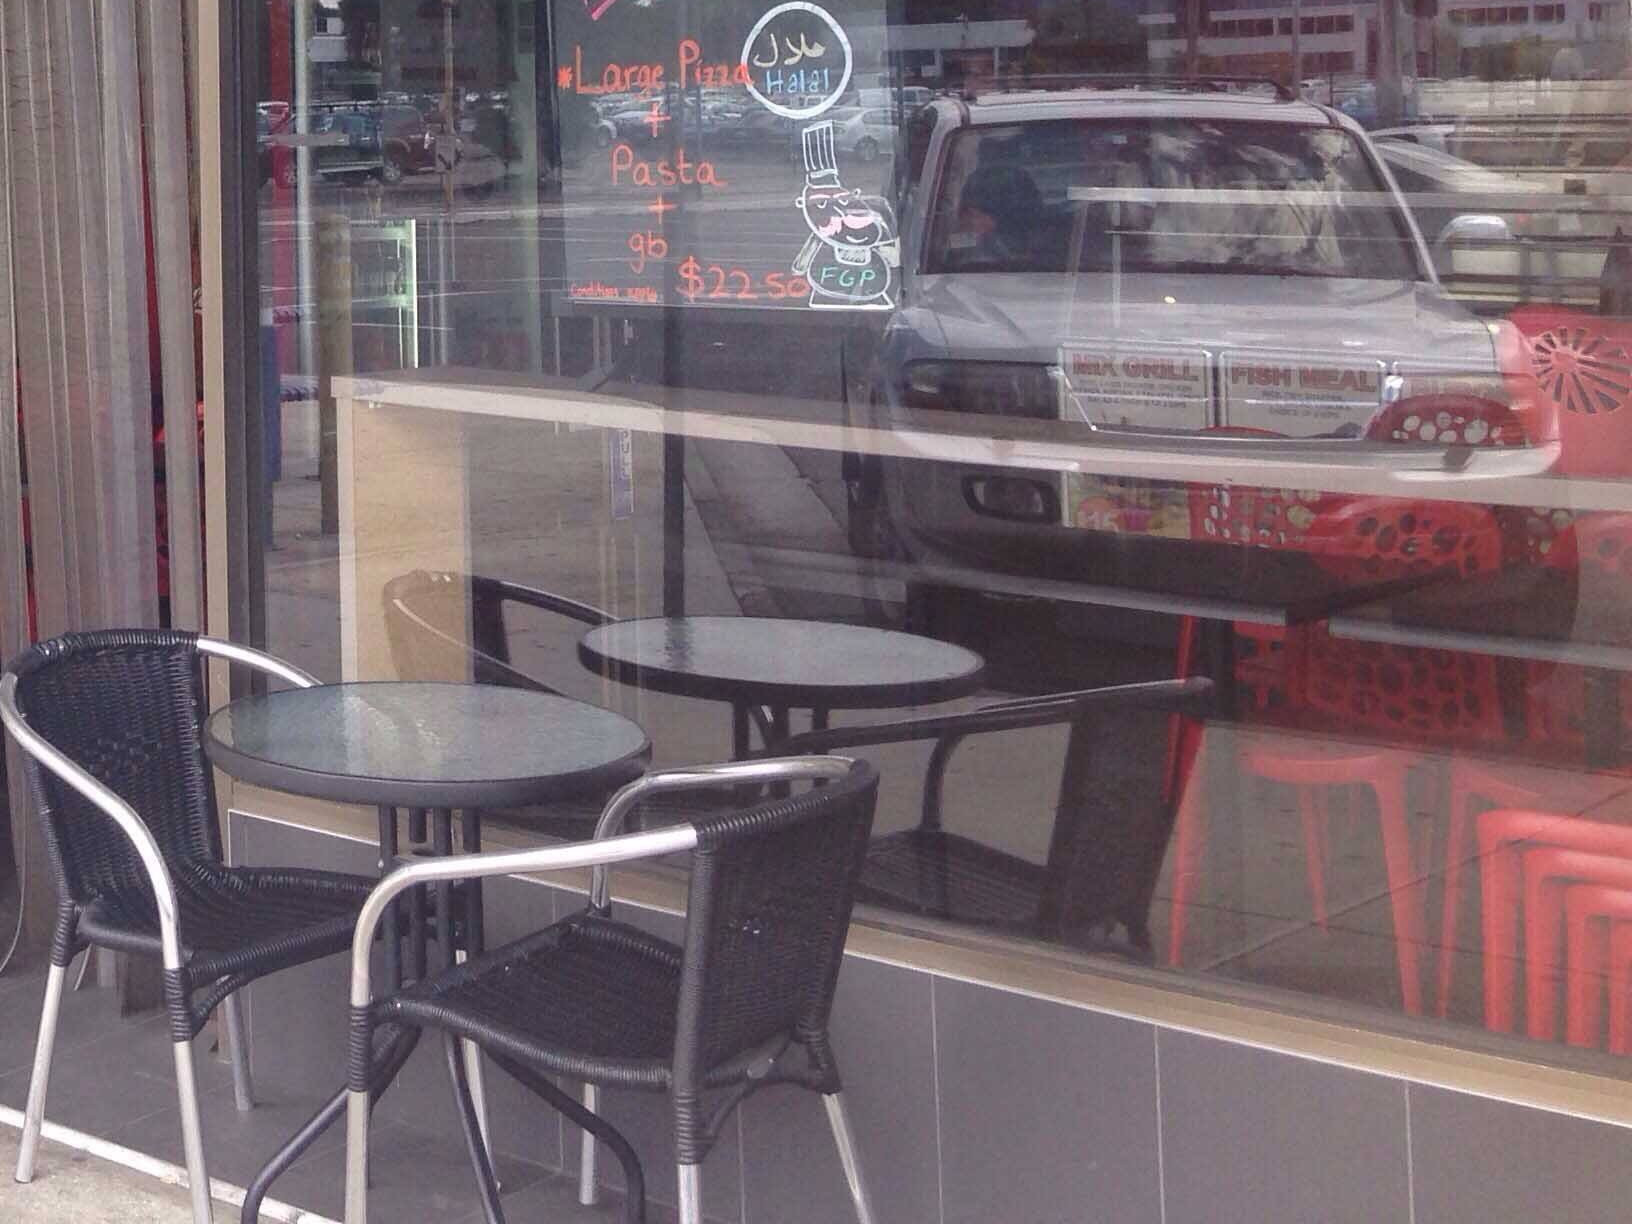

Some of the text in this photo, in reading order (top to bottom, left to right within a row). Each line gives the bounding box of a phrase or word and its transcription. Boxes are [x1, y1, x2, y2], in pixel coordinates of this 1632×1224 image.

[752, 31, 826, 69] حلال
[576, 39, 755, 101] Large Pizza
[766, 67, 830, 95] Halal
[609, 143, 728, 187] Pasta
[627, 231, 669, 274] gb
[819, 265, 878, 289] FGP
[1231, 365, 1378, 393] FISH MEAL
